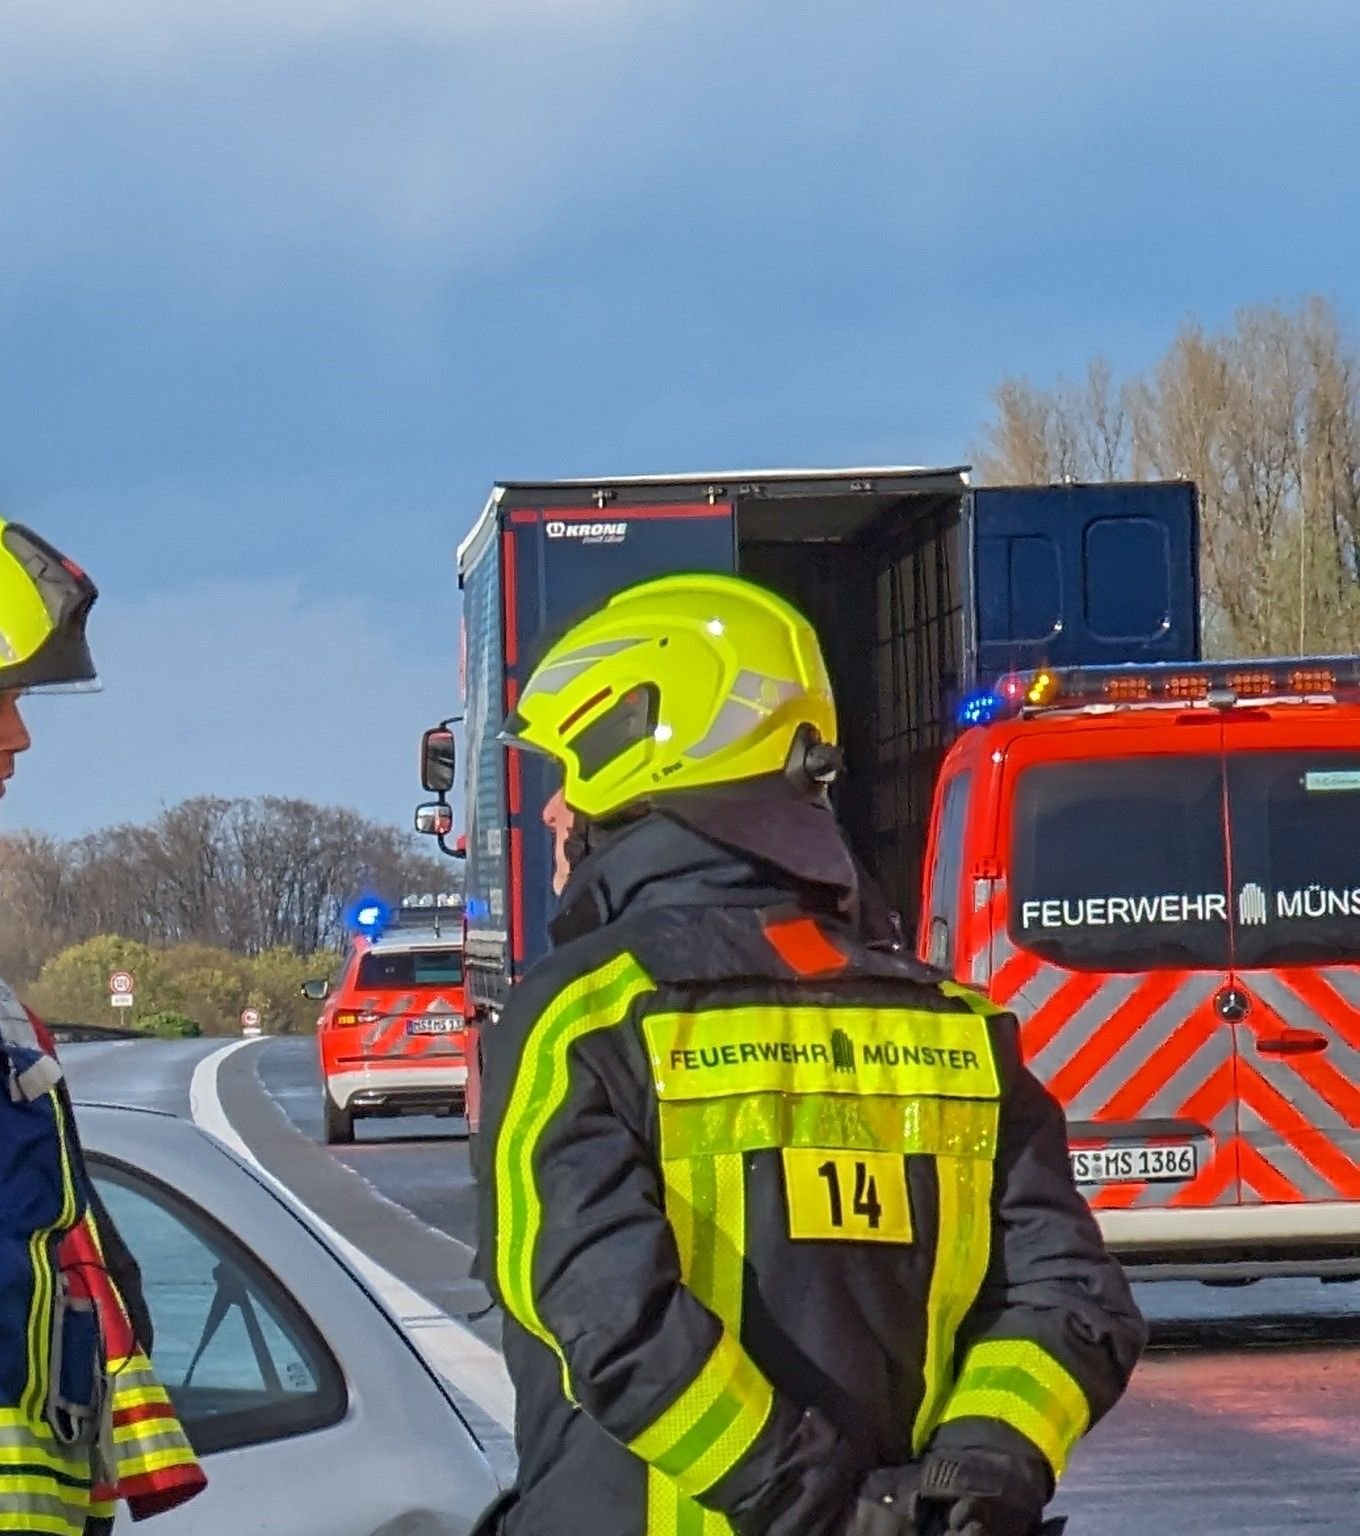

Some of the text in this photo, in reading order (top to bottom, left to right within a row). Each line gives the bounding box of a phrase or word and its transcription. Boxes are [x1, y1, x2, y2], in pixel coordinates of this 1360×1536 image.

[566, 523, 627, 537] KRONE
[1022, 894, 1227, 929] FEUERWEHR
[671, 1041, 980, 1071] FEUERWEHR MÜNSTER
[1072, 1149, 1192, 1177] S MS 1386
[818, 1160, 882, 1229] 14
